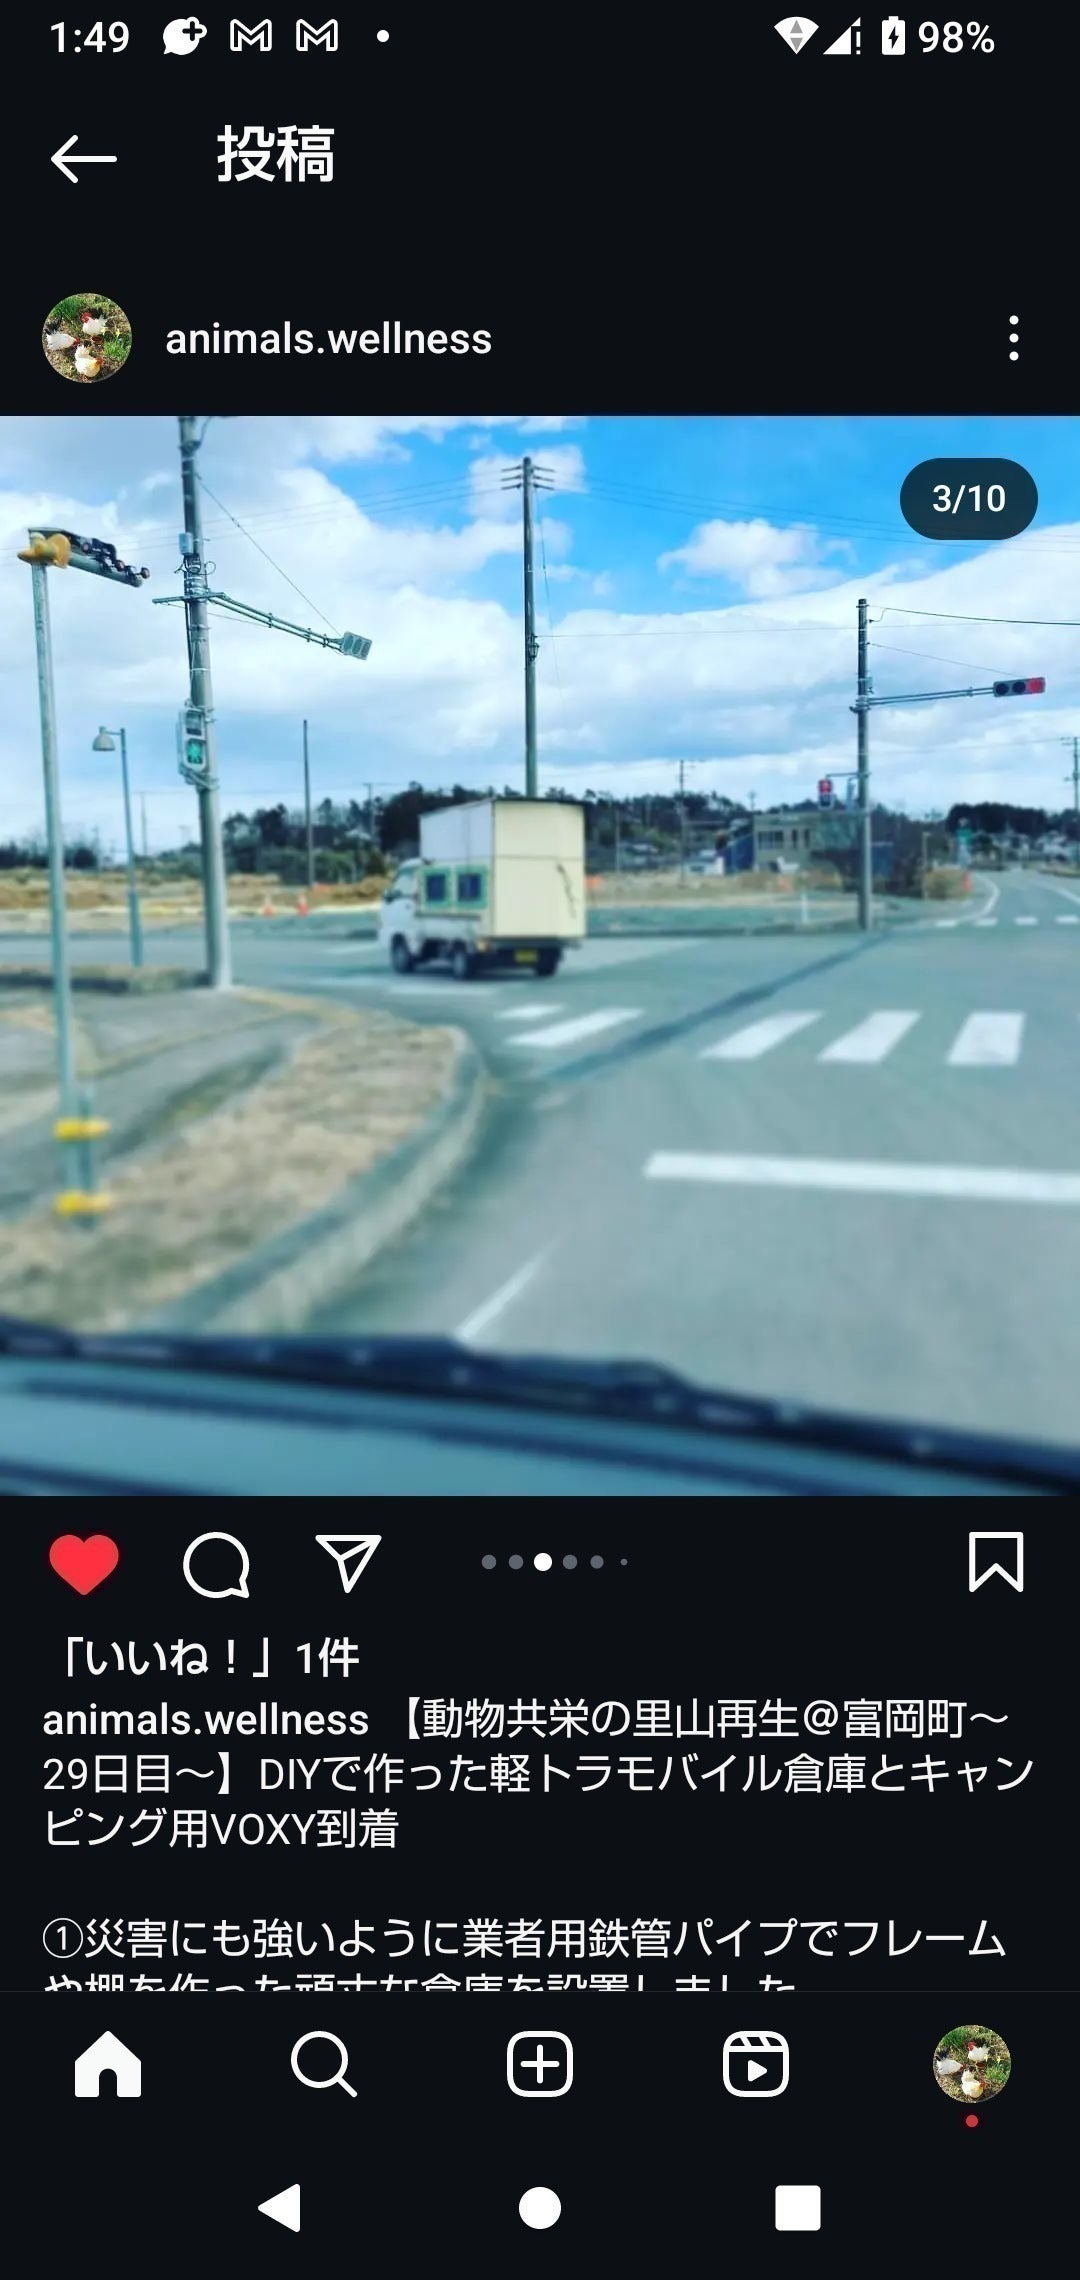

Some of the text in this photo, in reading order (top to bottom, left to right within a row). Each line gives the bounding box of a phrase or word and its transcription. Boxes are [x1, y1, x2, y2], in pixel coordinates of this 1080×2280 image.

[51, 20, 130, 53] 1:49
[918, 20, 996, 55] 98%
[216, 124, 336, 183] 投稿
[166, 320, 492, 355] animals.wellness
[932, 484, 1007, 514] 3/10
[43, 1701, 369, 1736] animals.wellness
[47, 1807, 400, 1849] ピング用VOXY到着
[43, 1917, 1007, 1959] ①災害にも強いように業者用鉄管パイプでフレーム
